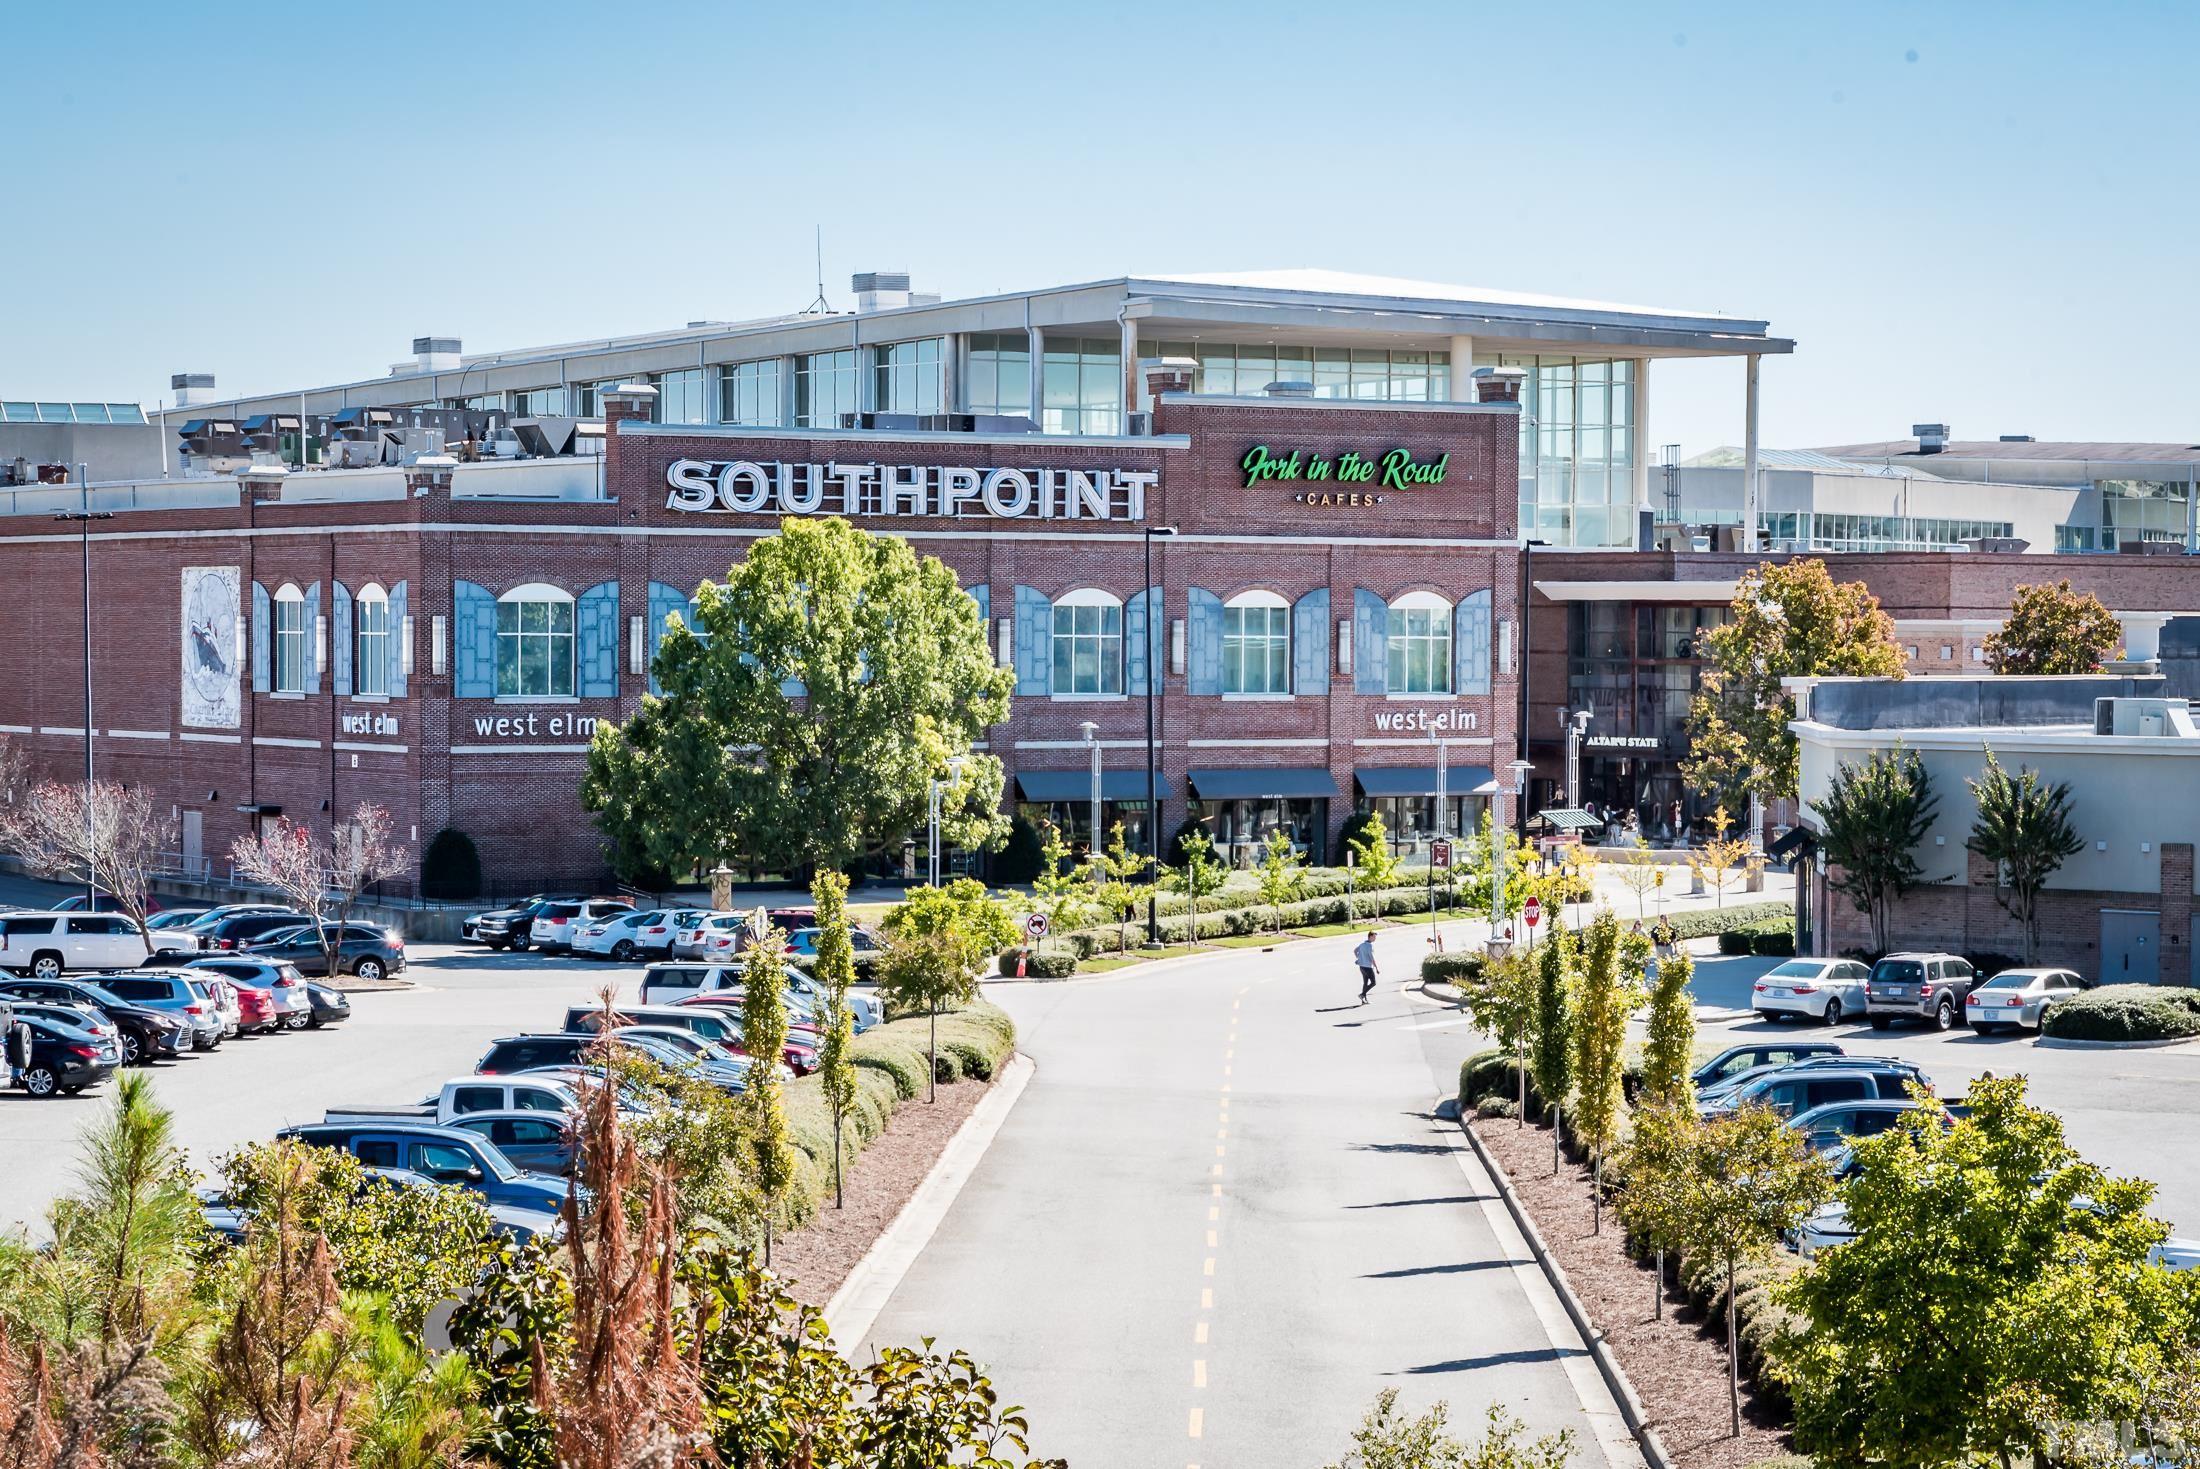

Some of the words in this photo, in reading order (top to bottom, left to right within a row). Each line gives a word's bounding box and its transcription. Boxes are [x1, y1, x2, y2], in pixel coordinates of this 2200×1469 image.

[1243, 446, 1301, 488] Fork
[1307, 453, 1332, 481] in
[1336, 452, 1375, 482] the
[1382, 448, 1450, 490] Road
[666, 459, 1158, 520] SOUTHPOINT
[1306, 492, 1373, 507] CAFES
[342, 712, 373, 734] west
[375, 712, 398, 735] elm
[475, 713, 538, 736] west
[549, 713, 597, 736] elm
[1375, 708, 1427, 730] west
[1436, 708, 1476, 730] elm
[1628, 737, 1658, 748] STATE
[1525, 905, 1539, 918] STOP
